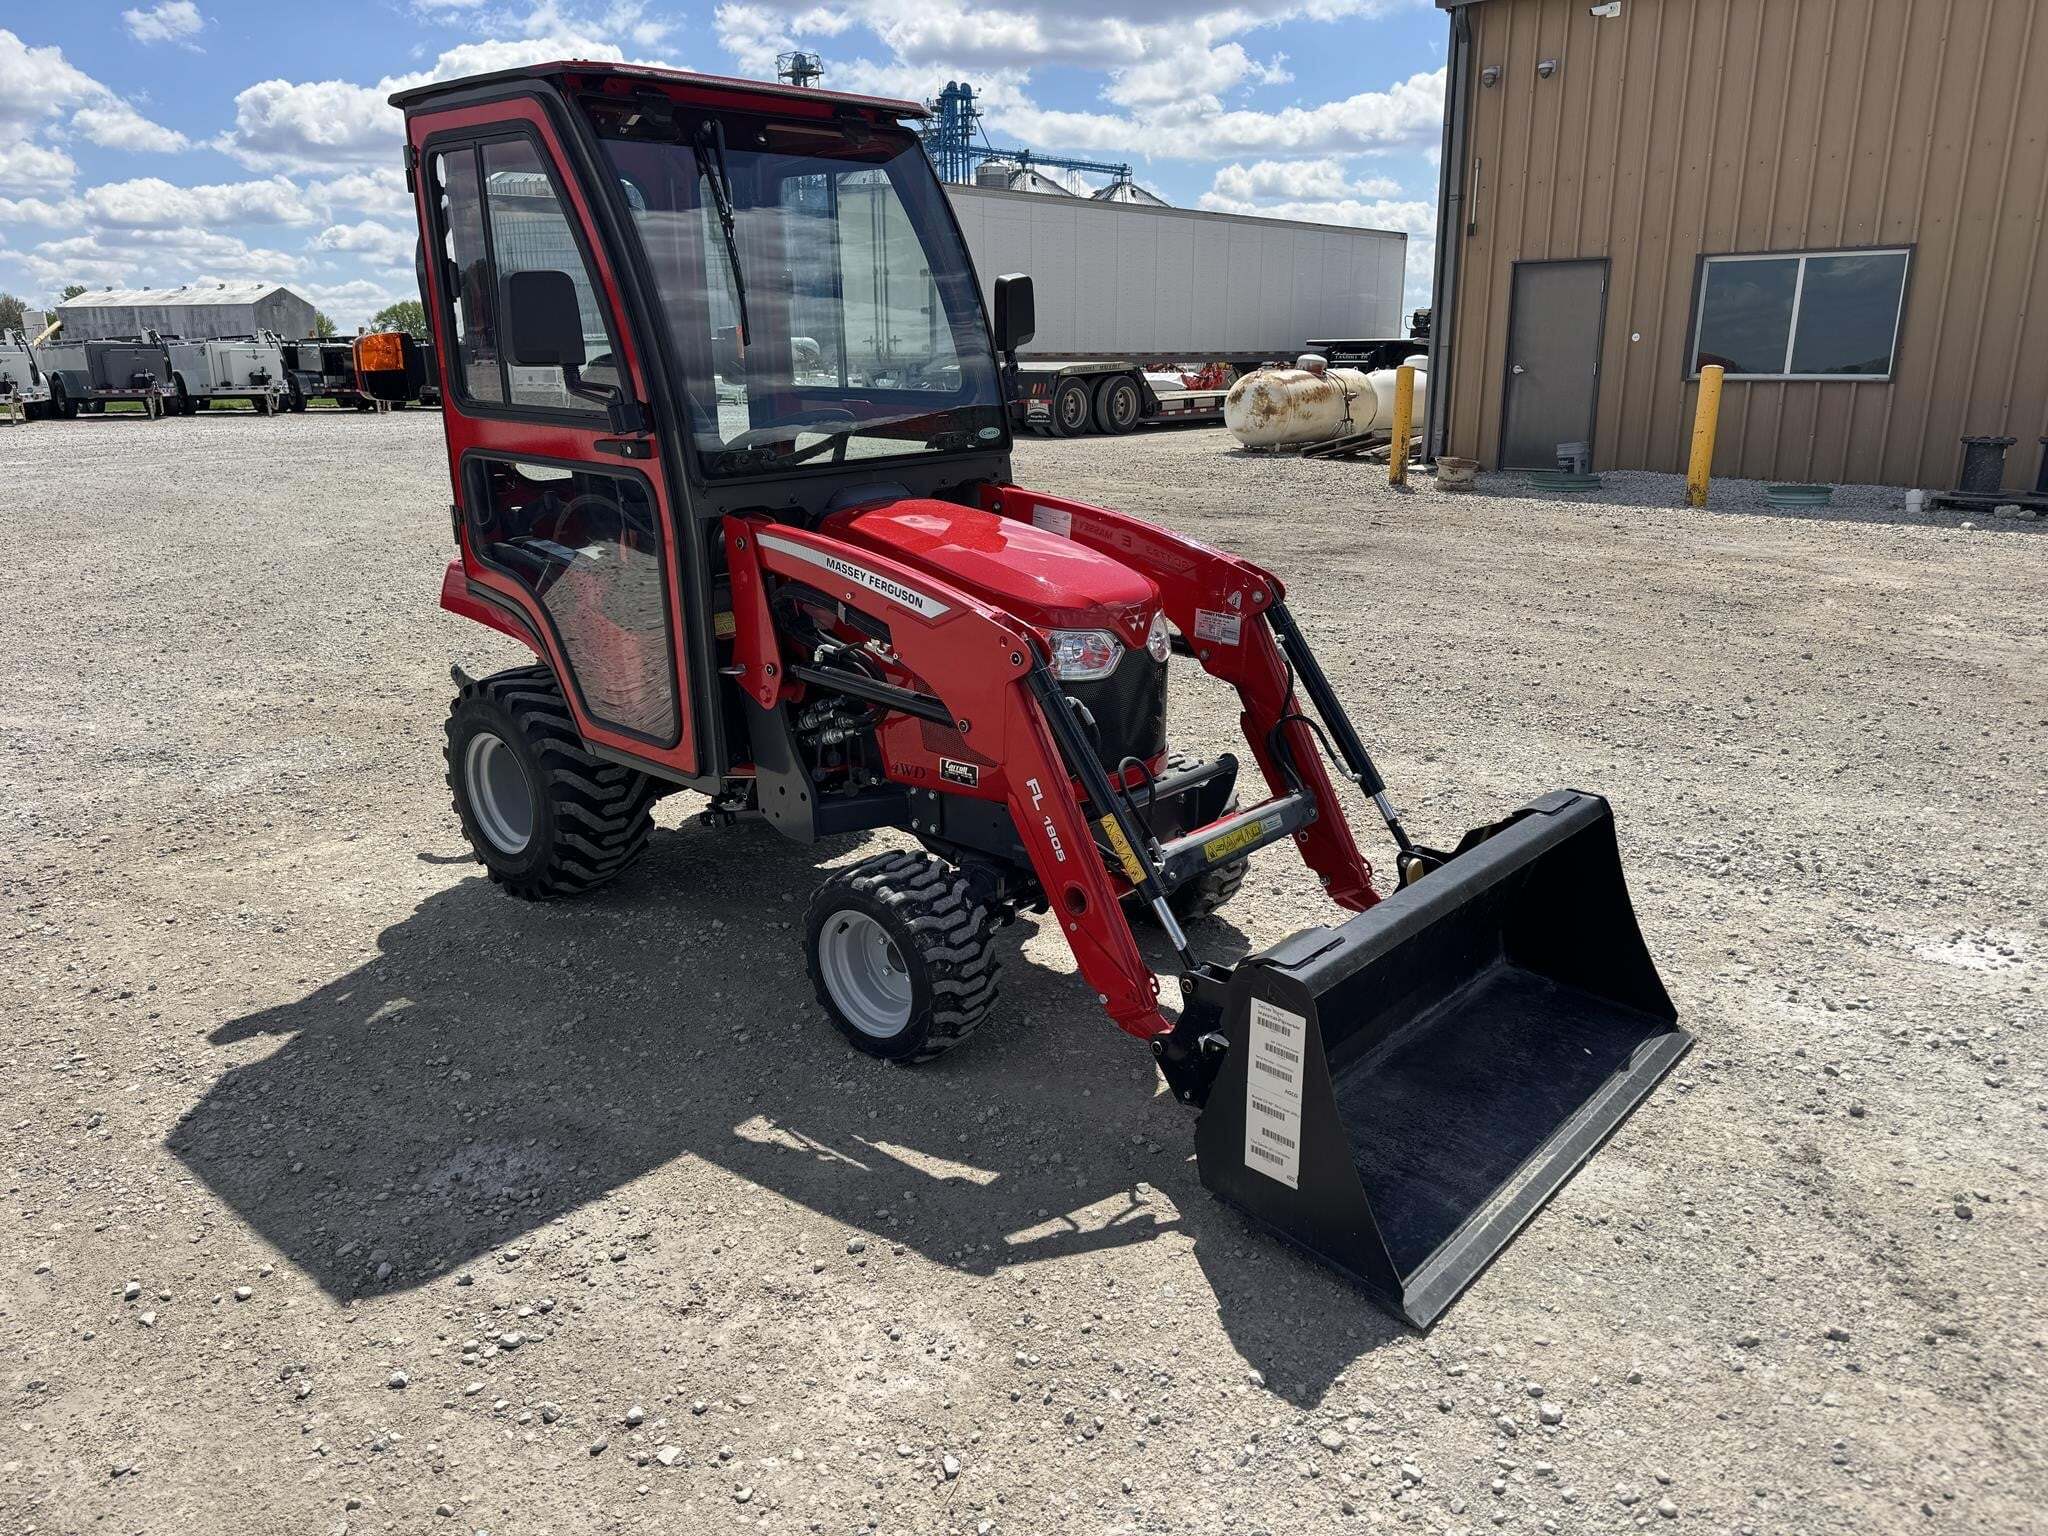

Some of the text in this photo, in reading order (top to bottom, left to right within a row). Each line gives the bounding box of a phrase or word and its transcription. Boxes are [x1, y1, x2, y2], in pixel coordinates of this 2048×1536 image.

[826, 557, 923, 609] MASSEY FERGUSON
[891, 762, 927, 779] 4WD
[1026, 778, 1066, 862] FL 1805
